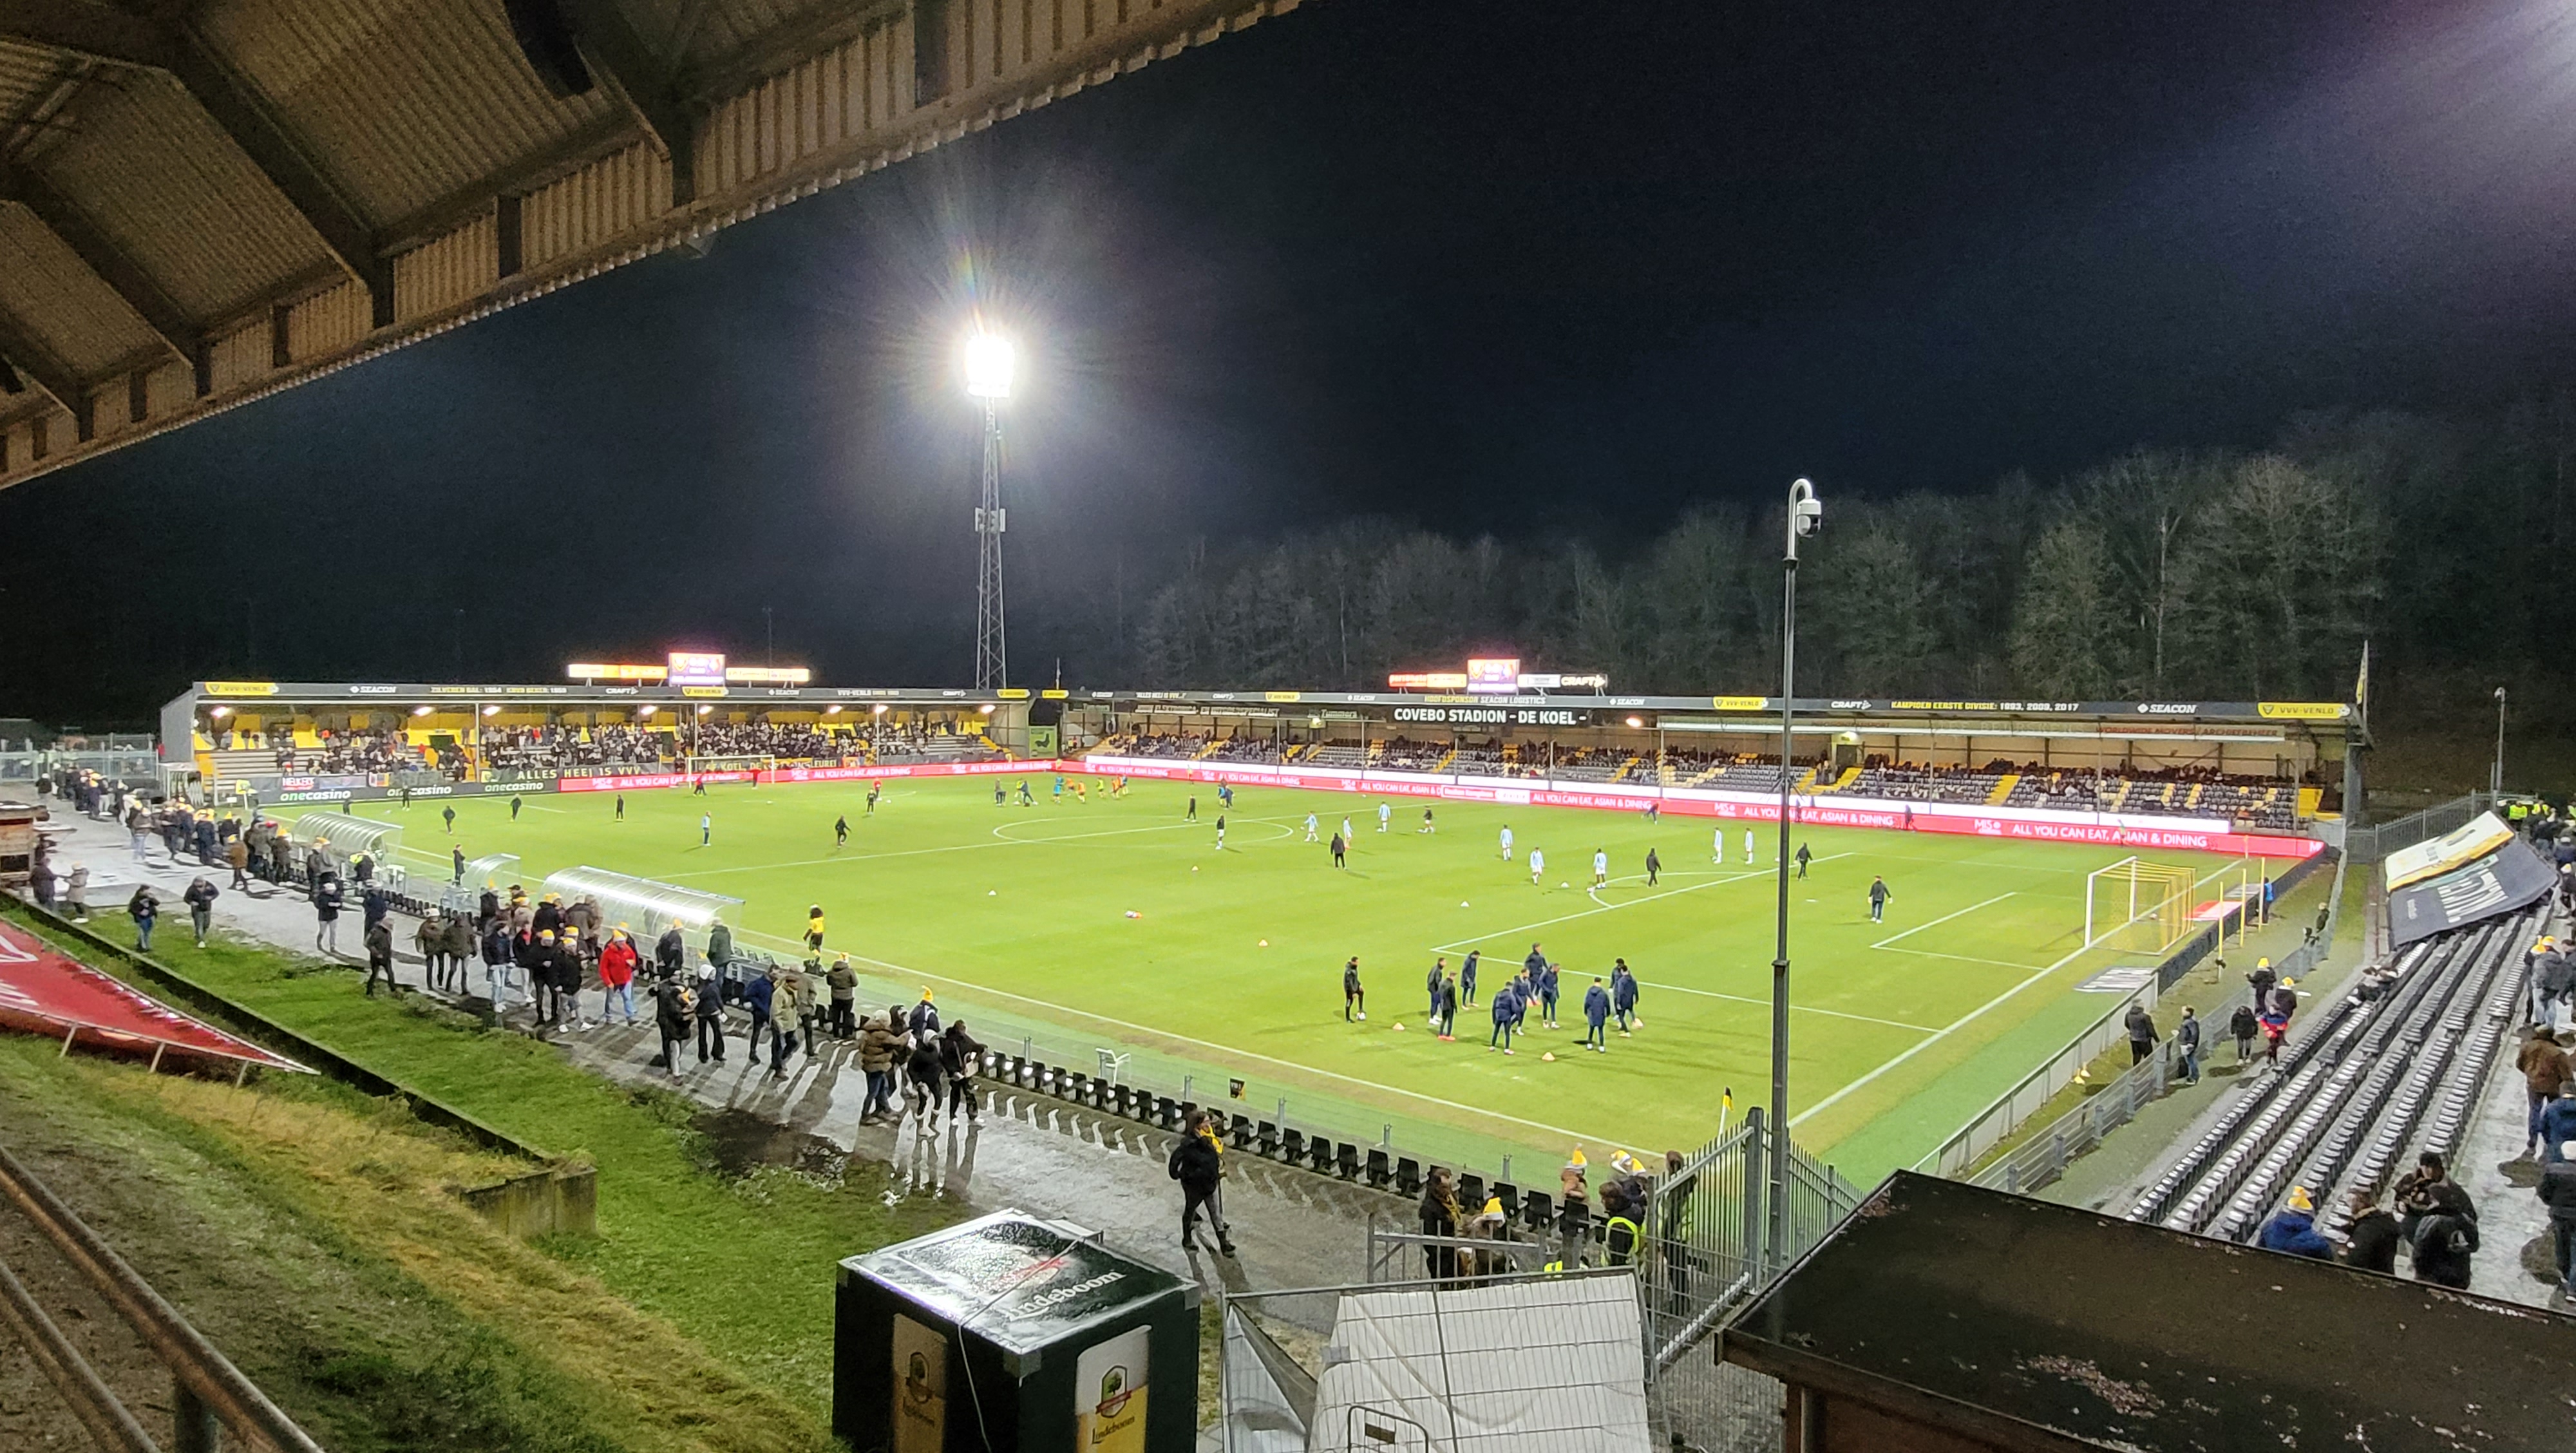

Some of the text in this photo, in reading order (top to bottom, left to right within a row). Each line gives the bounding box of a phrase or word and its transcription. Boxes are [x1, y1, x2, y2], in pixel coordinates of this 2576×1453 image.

[1561, 677, 1596, 686] CRAFT
[1510, 696, 1546, 705] LOGISTICS
[2149, 704, 2197, 714] SEACON
[1394, 708, 1446, 721] COVEBO
[1448, 710, 1507, 723] STADION
[1517, 710, 1537, 724] DE
[1539, 710, 1577, 725] KOEL
[517, 769, 557, 780] ALLES
[564, 768, 592, 779] HEEJ
[600, 767, 612, 777] IS
[485, 781, 544, 792] onecasino
[1412, 785, 1429, 794] ASIAN
[280, 788, 351, 801] onecasino
[1533, 793, 1544, 801] ALL
[1546, 793, 1561, 802] YOU
[1562, 794, 1578, 803] CAN
[1594, 797, 1615, 806] ASIAN
[1617, 799, 1624, 807] &
[1625, 799, 1651, 810] DINING
[1744, 807, 1758, 816] ALL
[1760, 808, 1779, 818] YOU
[1821, 812, 1848, 822] ASIAN
[1850, 813, 1857, 822] &
[1859, 814, 1893, 826] DINING
[2012, 823, 2032, 835] ALL
[2034, 825, 2059, 836] YOU
[2061, 826, 2085, 838] CAN
[2088, 828, 2110, 841] EAT,
[2112, 830, 2148, 843] AIAN
[2152, 832, 2161, 844] &
[2163, 835, 2207, 848] DINING
[1092, 1416, 1135, 1445] Lindeboom
